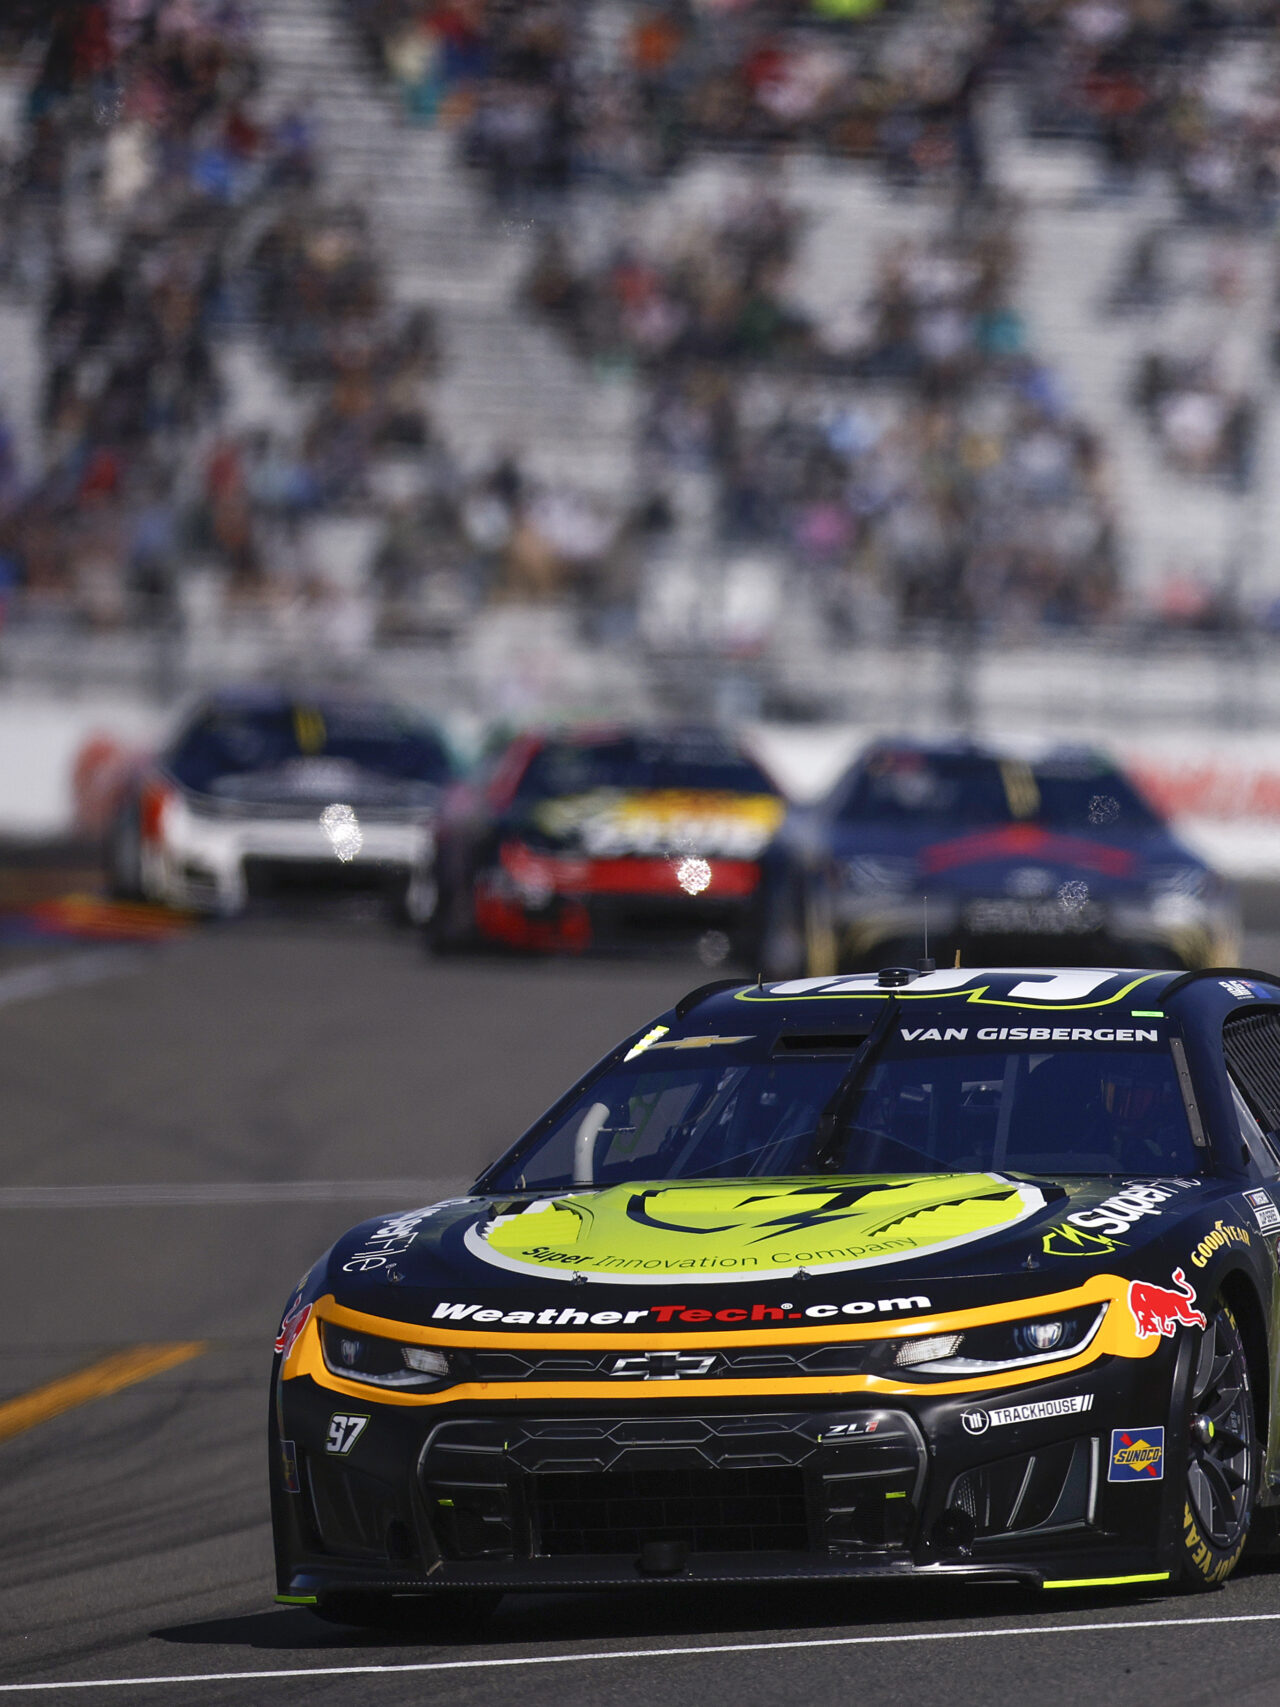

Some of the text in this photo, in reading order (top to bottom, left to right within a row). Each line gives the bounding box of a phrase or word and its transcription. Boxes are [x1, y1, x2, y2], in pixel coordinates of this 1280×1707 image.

[900, 1027, 1159, 1042] VAN GISBERGEN
[522, 1237, 918, 1269] Super Innovation Company
[1190, 1219, 1251, 1268] GOODYEAR
[994, 1398, 1079, 1425] TRACKHOUSE
[326, 1415, 368, 1454] 97
[826, 1418, 880, 1437] ZL1
[1113, 1446, 1163, 1464] SUNOCO
